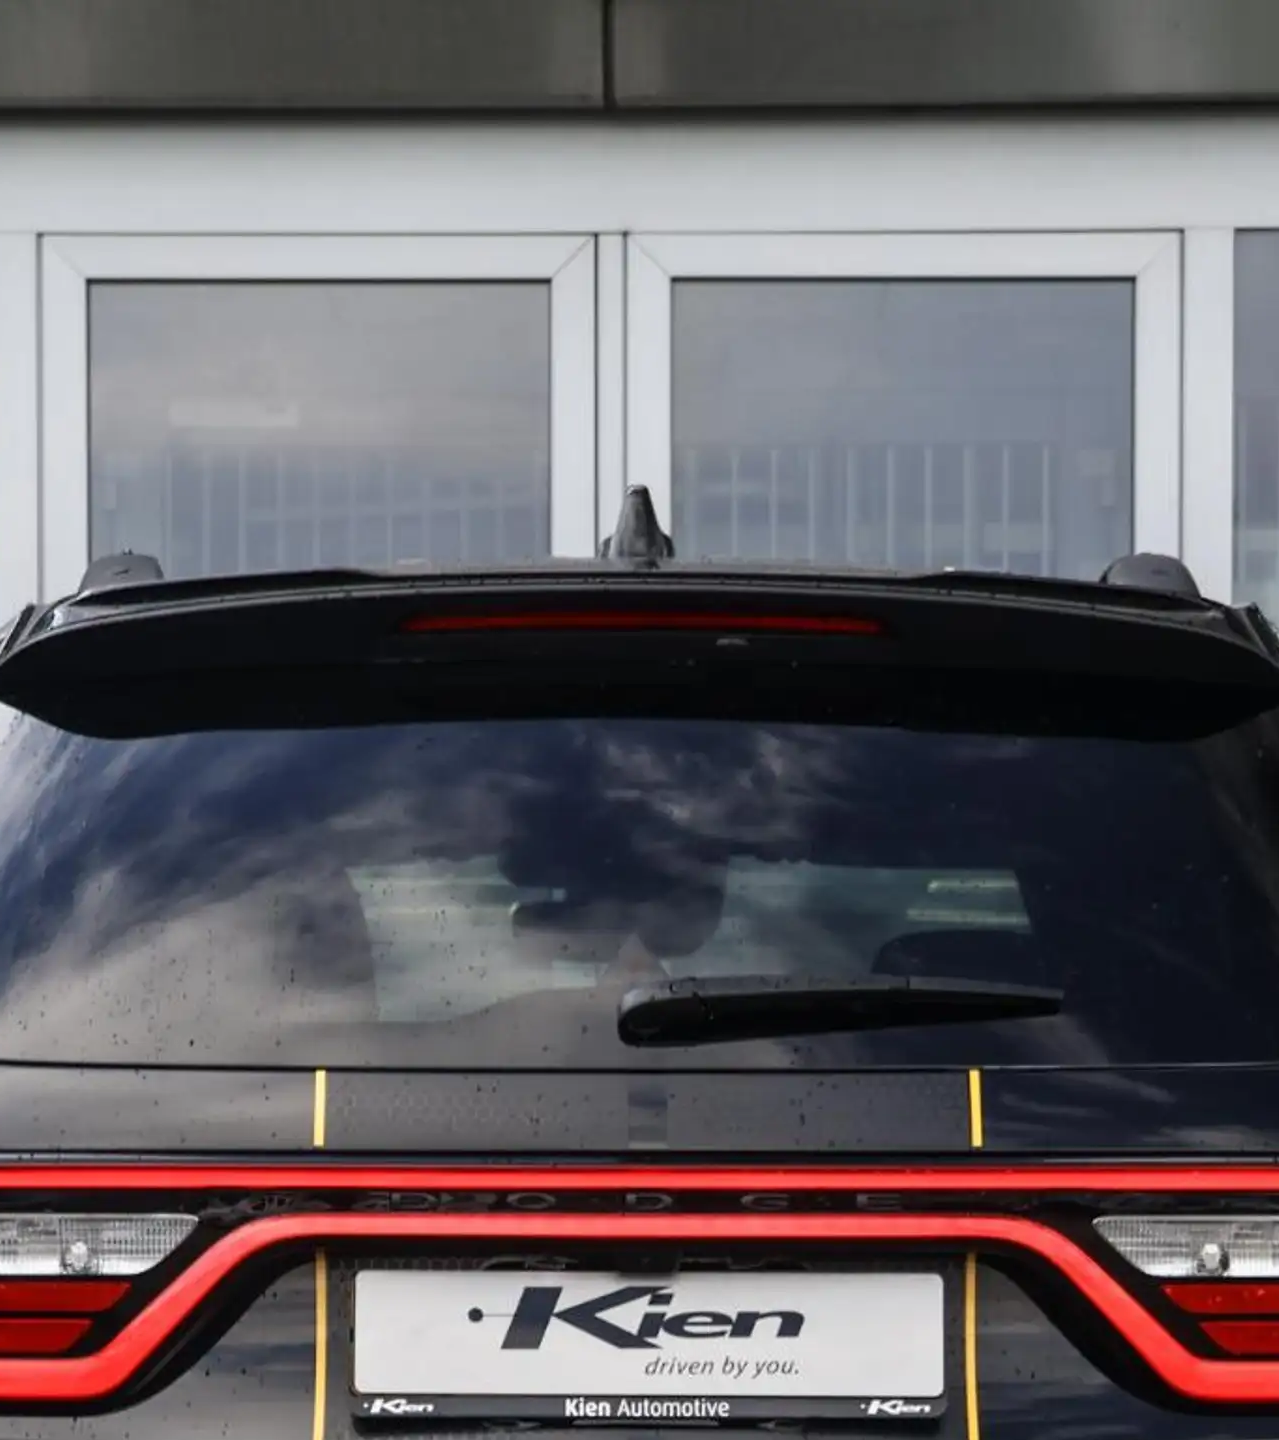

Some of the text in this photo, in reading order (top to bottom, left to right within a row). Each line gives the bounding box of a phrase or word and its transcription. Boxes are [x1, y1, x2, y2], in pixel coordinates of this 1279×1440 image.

[390, 1191, 904, 1212] DODGE
[499, 1286, 806, 1350] Kien
[644, 1357, 801, 1379] driven by you.
[564, 1397, 731, 1418] Kien Automotive
